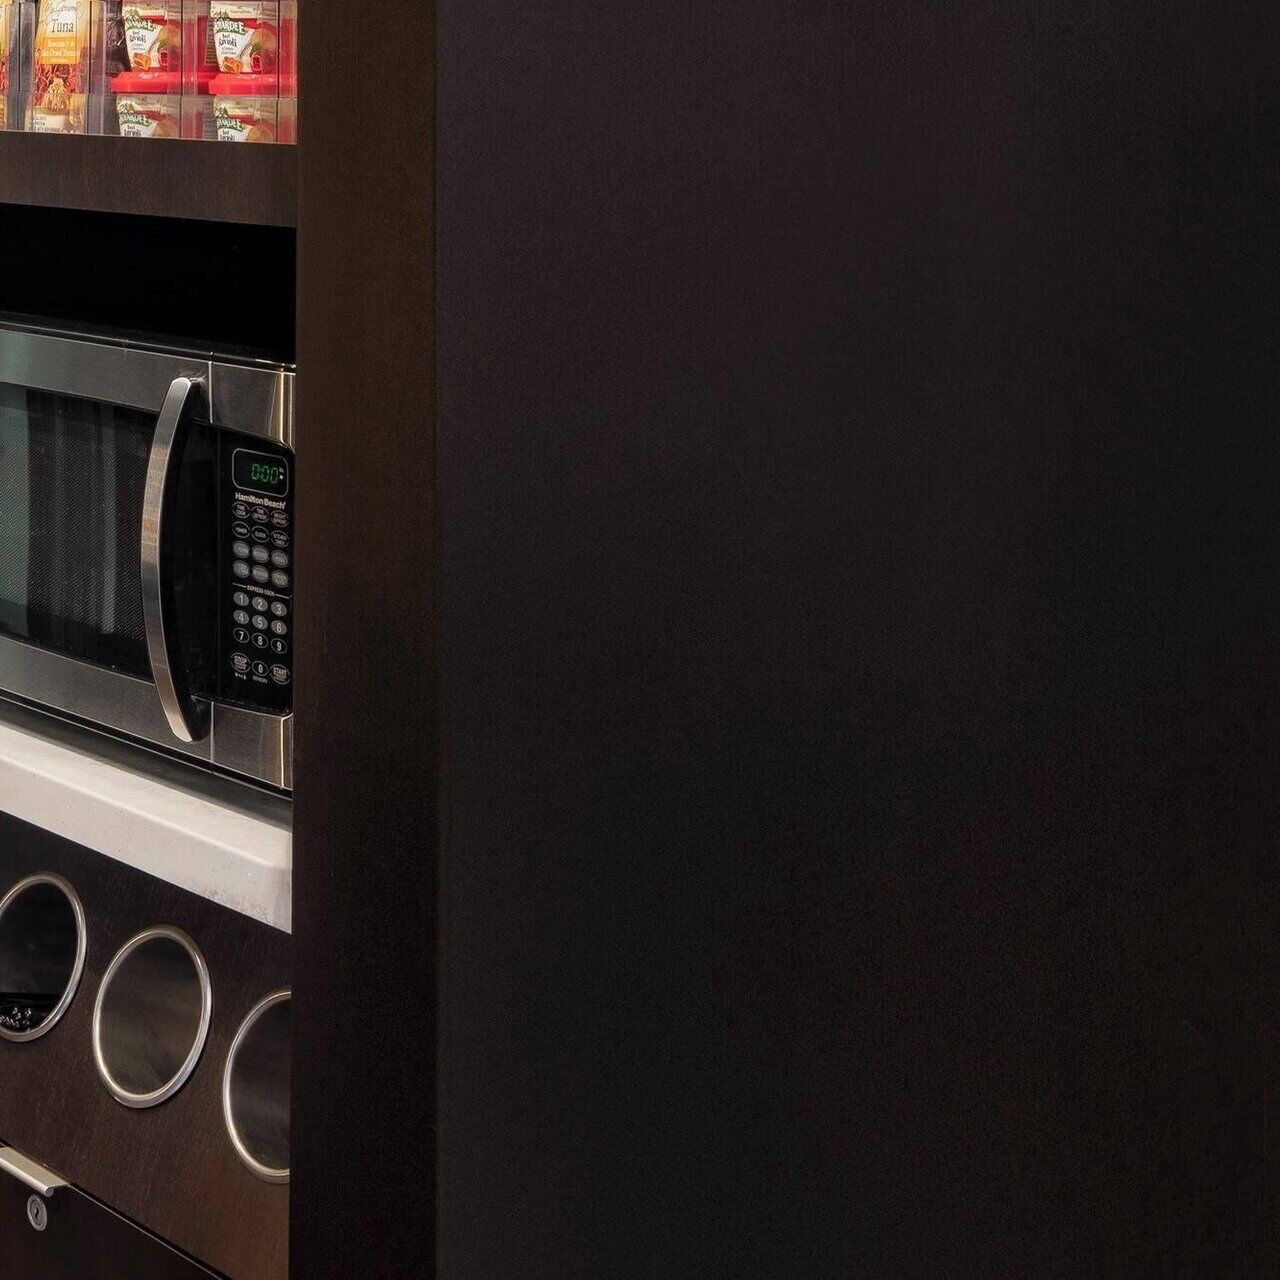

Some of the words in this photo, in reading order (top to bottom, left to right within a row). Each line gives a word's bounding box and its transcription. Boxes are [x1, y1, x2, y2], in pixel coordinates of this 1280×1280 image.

[51, 20, 74, 33] Tuna
[251, 464, 278, 484] 0:00
[235, 492, 264, 506] Hamilton
[264, 497, 286, 510] Beach
